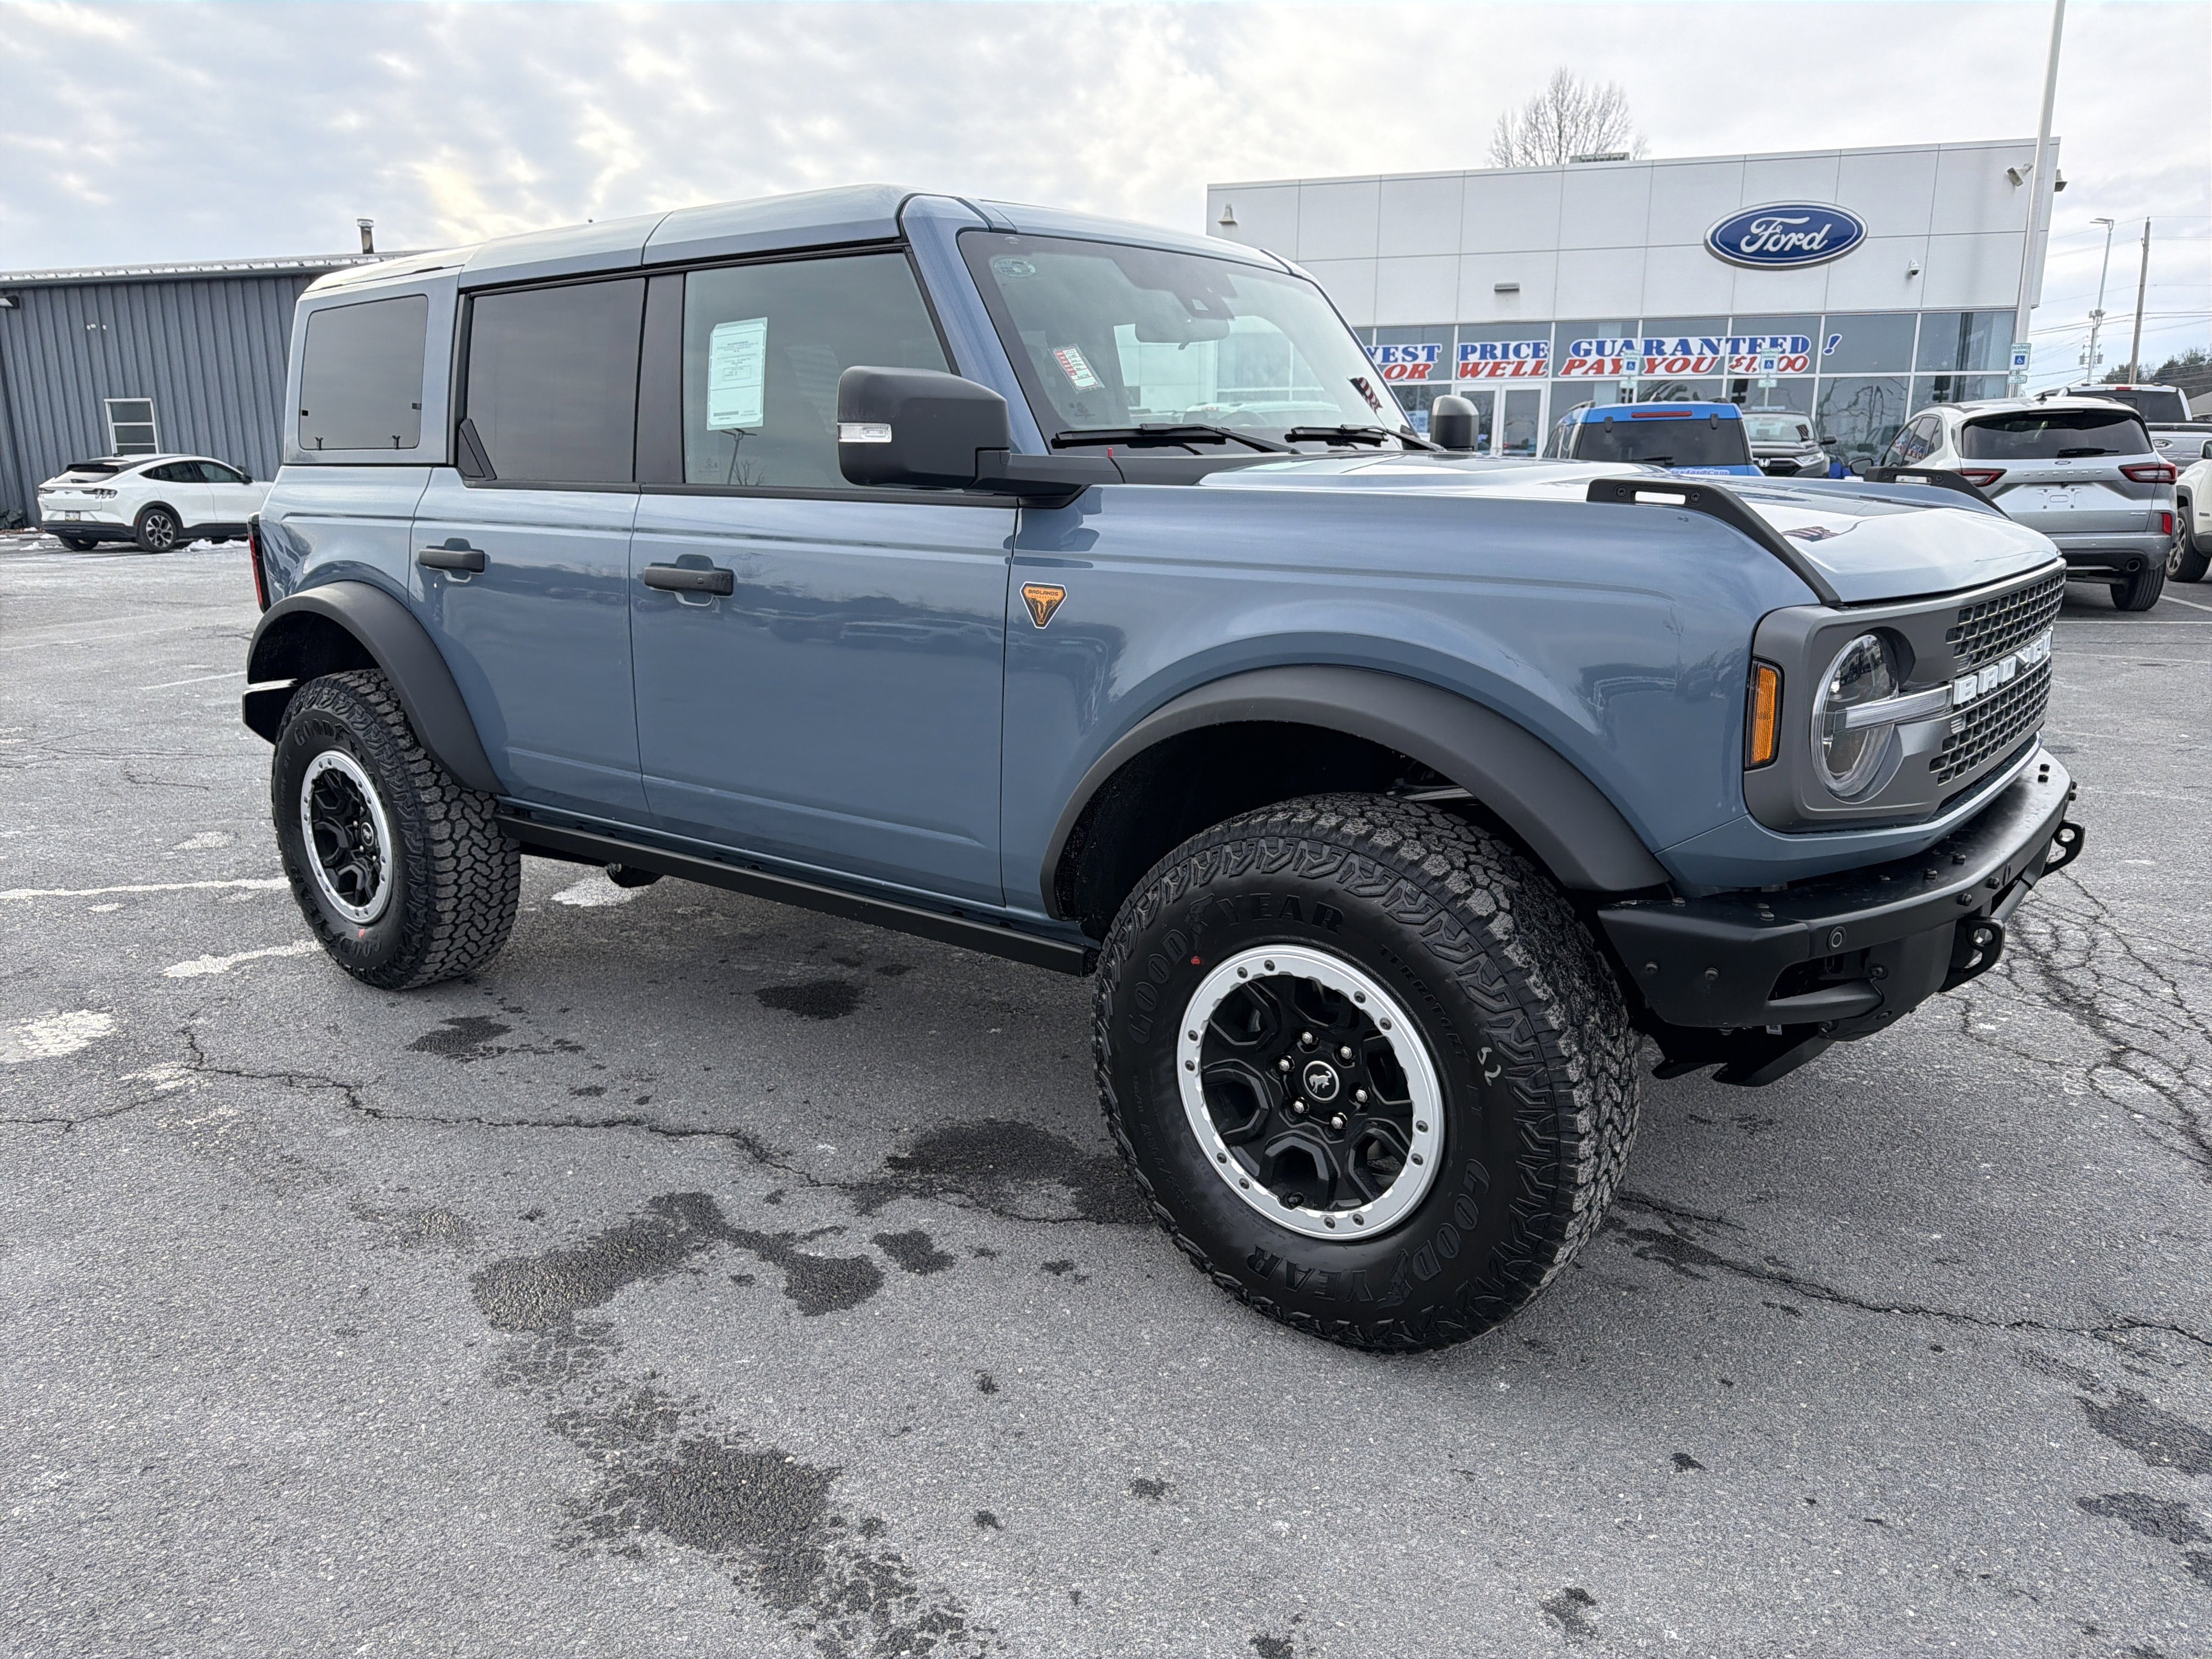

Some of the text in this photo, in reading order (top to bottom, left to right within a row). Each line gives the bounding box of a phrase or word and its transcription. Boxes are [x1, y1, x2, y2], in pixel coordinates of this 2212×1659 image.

[1740, 216, 1832, 253] Ford
[1459, 342, 1549, 361] PRICE
[1571, 337, 1810, 357] GUARANTEED
[1384, 363, 1431, 380] OR
[1459, 360, 1547, 379] WE'LL
[1644, 357, 1718, 374] YOU
[1729, 356, 1808, 373] $1,00
